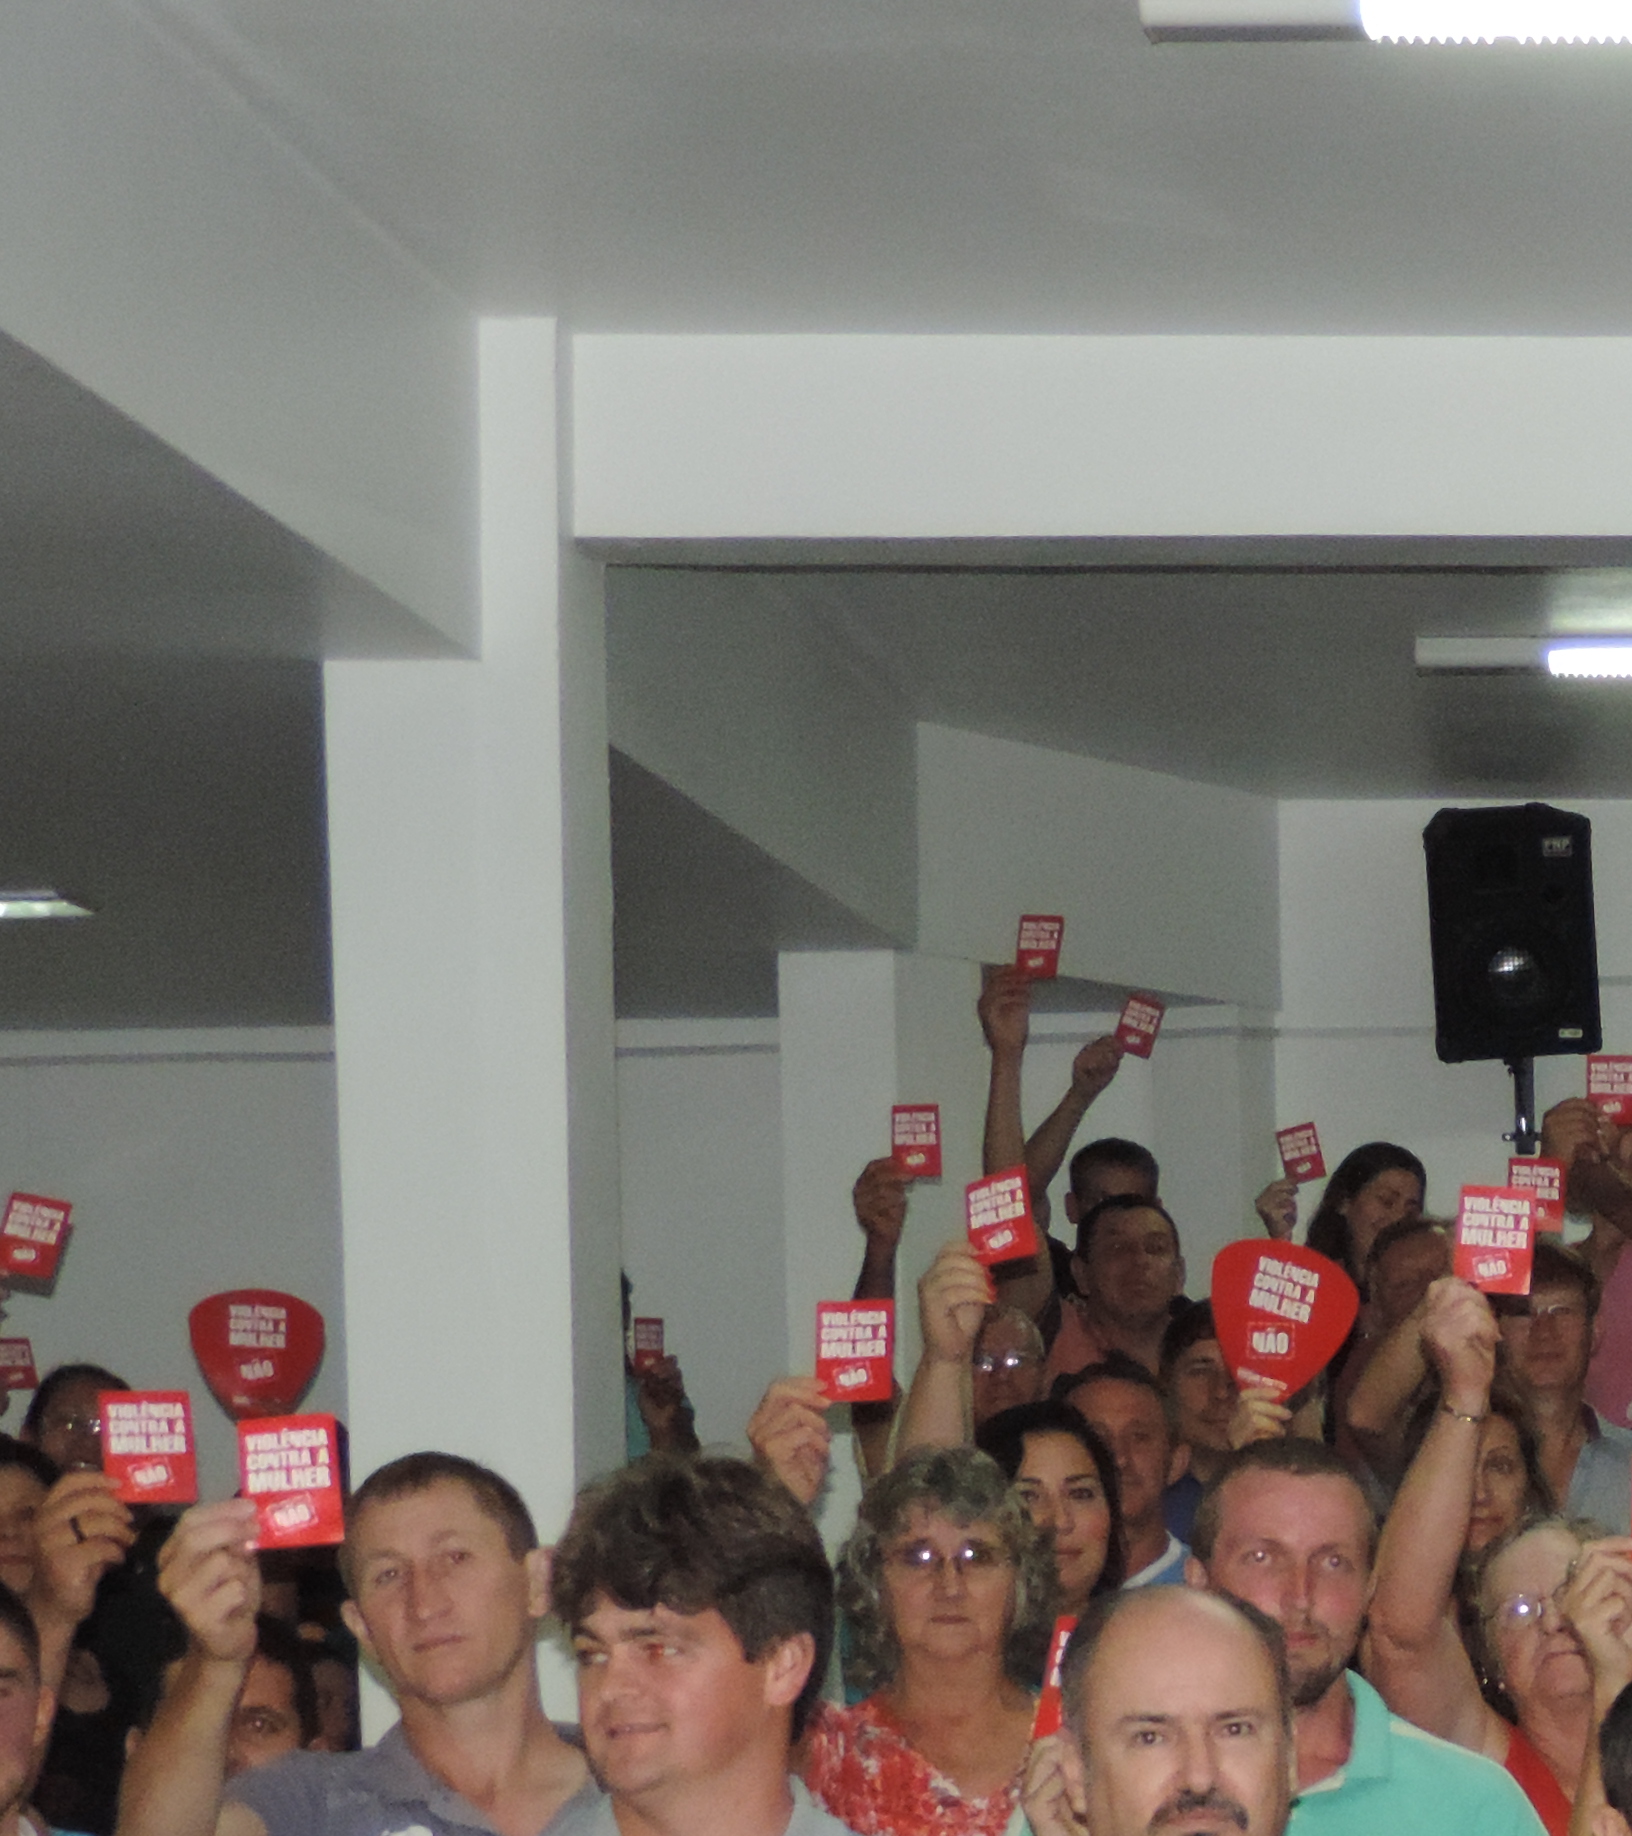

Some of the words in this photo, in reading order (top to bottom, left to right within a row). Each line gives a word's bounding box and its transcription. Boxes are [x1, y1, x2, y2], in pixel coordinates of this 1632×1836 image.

[1464, 1197, 1529, 1214] VIOLÊNCIA
[1462, 1211, 1513, 1229] CONTRA
[1461, 1226, 1526, 1248] MULHER
[1259, 1257, 1318, 1287] VIOLÊNCIA
[1254, 1272, 1300, 1299] CONTRA
[1250, 1287, 1310, 1322] MULHER
[821, 1310, 886, 1326] VIOLÊNCIA
[821, 1325, 872, 1340] CONTRA
[820, 1339, 885, 1358] MULHER
[107, 1402, 183, 1419] VIOLÊNCIA
[108, 1418, 168, 1435] CONTRA
[109, 1434, 185, 1453] MULHER
[245, 1429, 327, 1451] VIOLÊNCIA
[246, 1448, 310, 1470] CONTRA
[247, 1465, 330, 1492] MULHER
